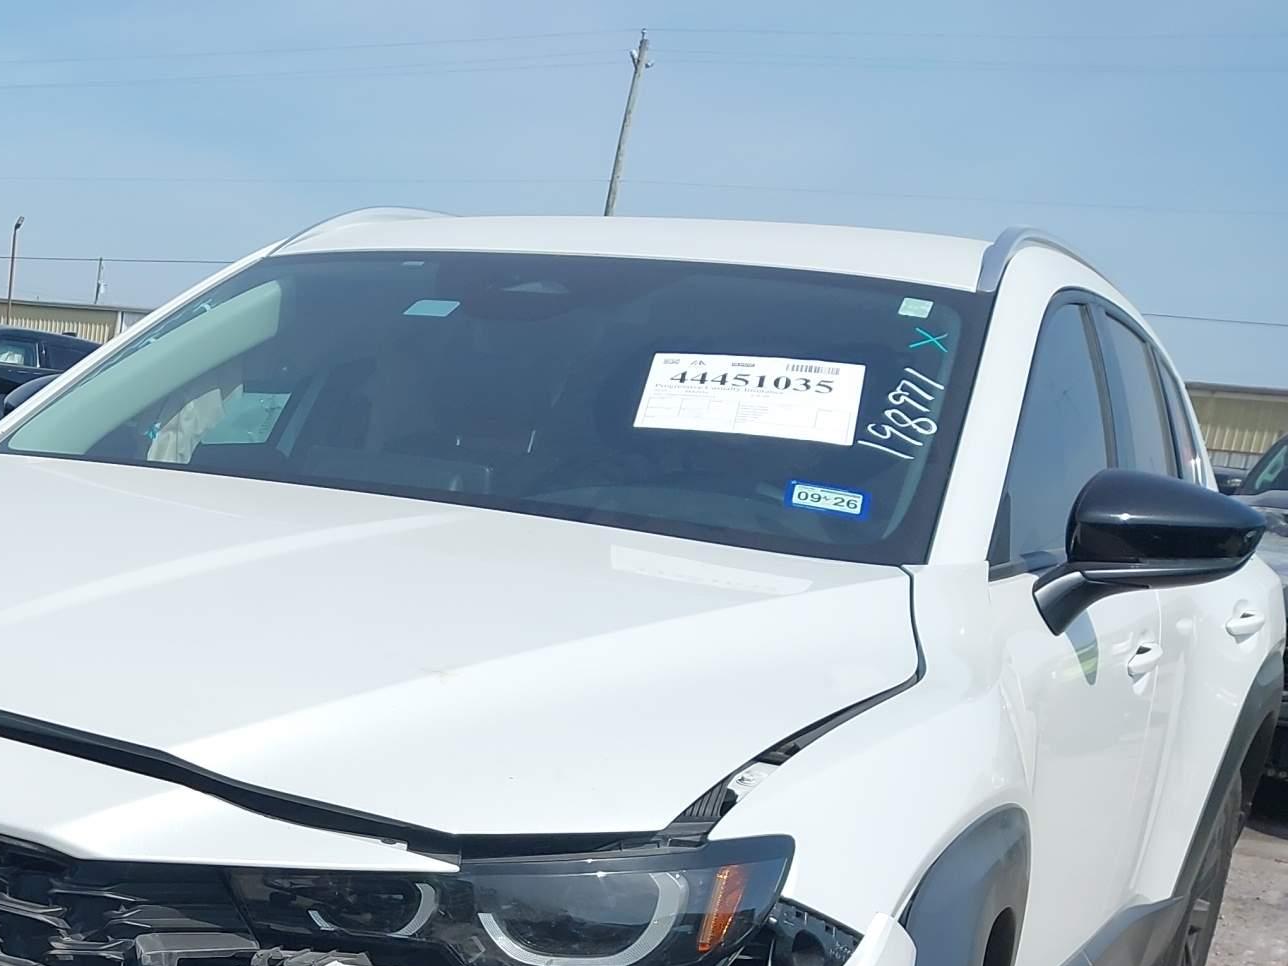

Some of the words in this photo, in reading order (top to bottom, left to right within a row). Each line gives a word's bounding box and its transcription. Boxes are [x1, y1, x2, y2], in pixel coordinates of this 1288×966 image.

[669, 370, 835, 394] 44451035
[797, 490, 822, 503] 09
[833, 496, 859, 510] 26
